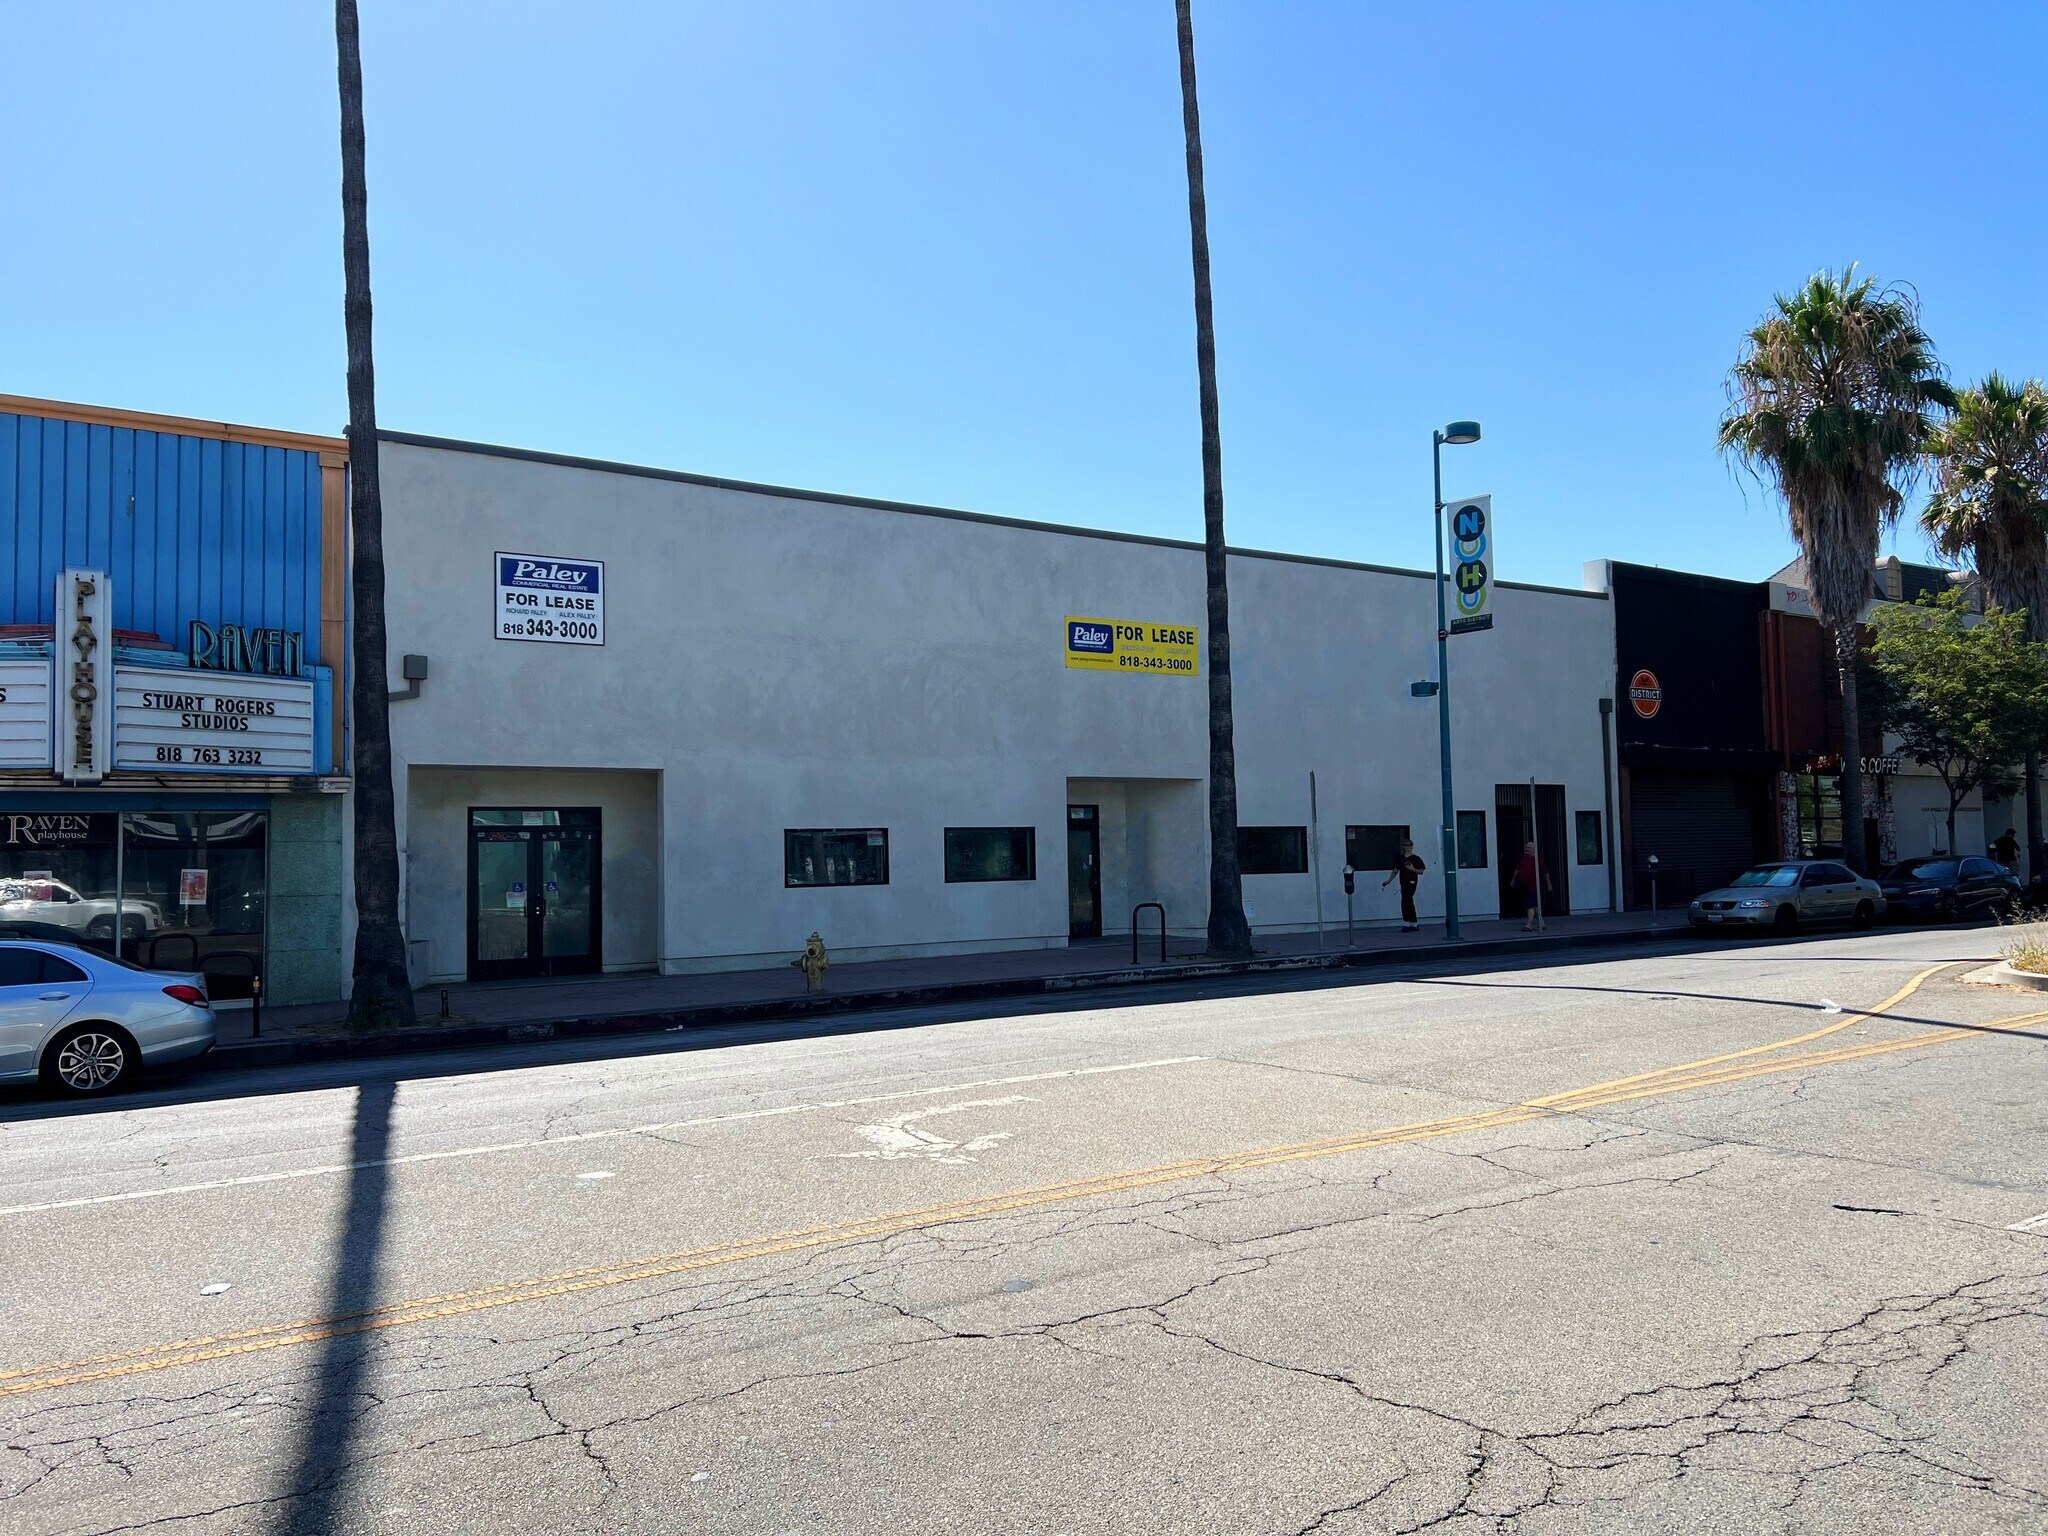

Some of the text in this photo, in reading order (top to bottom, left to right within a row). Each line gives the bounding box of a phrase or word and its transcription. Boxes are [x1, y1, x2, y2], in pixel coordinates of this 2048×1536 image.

[514, 561, 587, 585] Paley
[512, 580, 550, 588] COMMERCIAL
[505, 592, 595, 611] FOR LEASE
[576, 612, 596, 620] PALEY
[503, 618, 598, 640] 818 343-3000
[1073, 626, 1109, 645] Paley
[1116, 625, 1194, 645] FOR LEASE
[189, 619, 304, 677] RAVEN
[70, 580, 97, 764] PLAYHOUSE
[1119, 655, 1192, 671] 818-343-3000
[1631, 688, 1660, 700] DISTRICT
[143, 693, 275, 715] STUART ROGERS
[182, 714, 248, 731] STUDIOS
[157, 747, 262, 765] 818 763 3232
[1868, 757, 1902, 774] COFFEE
[6, 815, 91, 844] RAVEN
[37, 830, 88, 841] playhouse
